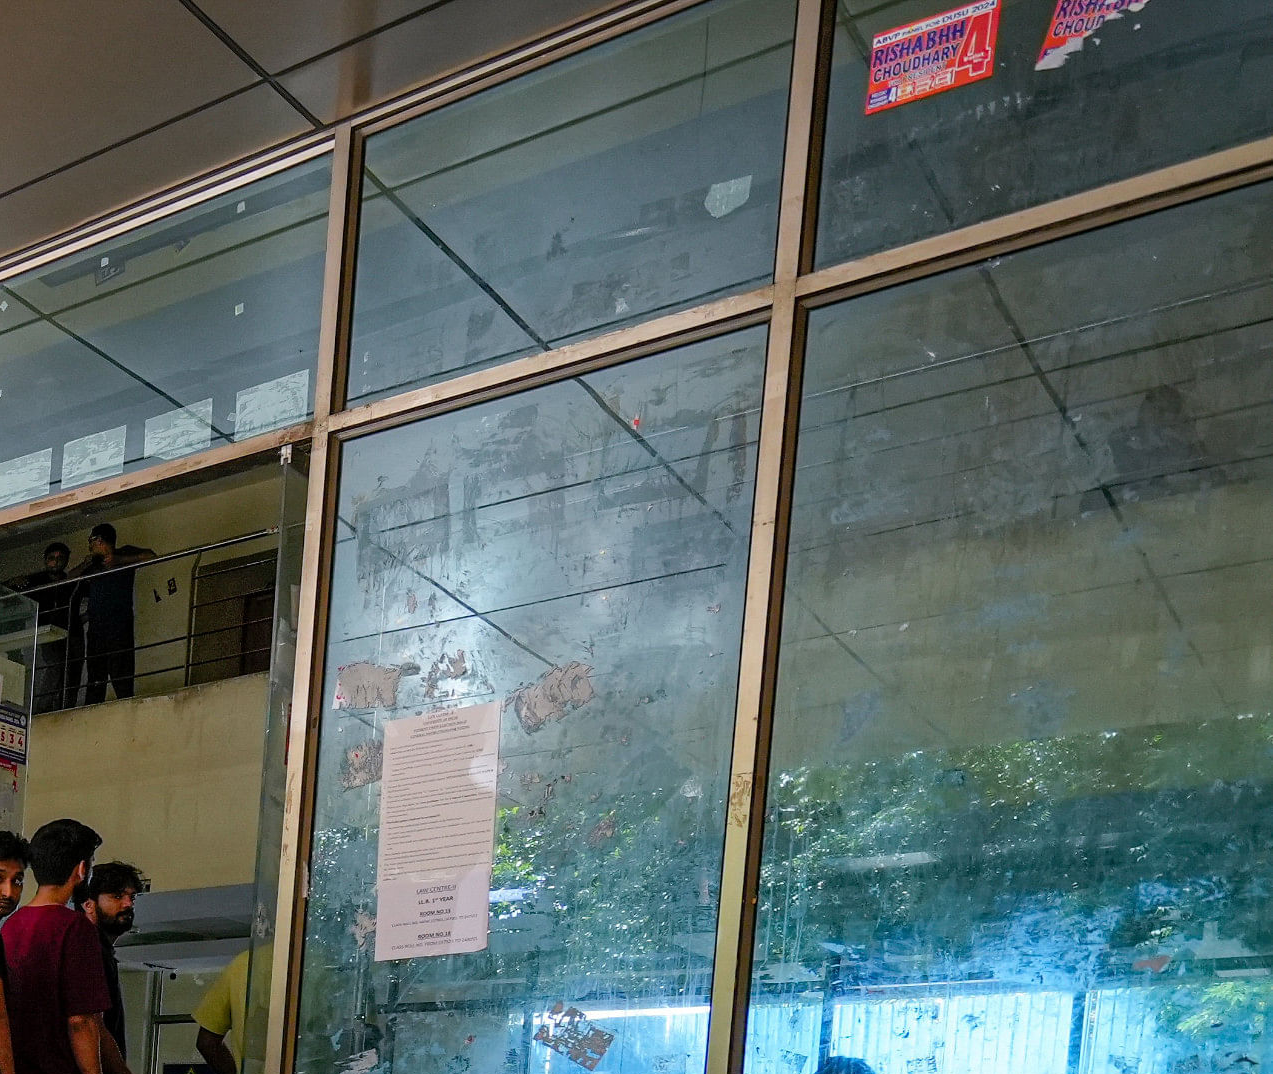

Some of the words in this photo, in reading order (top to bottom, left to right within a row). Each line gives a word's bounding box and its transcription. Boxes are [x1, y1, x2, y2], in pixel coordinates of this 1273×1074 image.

[873, 19, 966, 68] RISHABHH
[875, 32, 901, 46] ABVP
[941, 9, 969, 25] DUSU
[972, 1, 995, 13] 2024
[955, 9, 992, 77] 4
[873, 41, 960, 83] CHOUDHARY
[0, 731, 5, 743] 5
[9, 733, 15, 744] 3
[17, 736, 24, 747] 4
